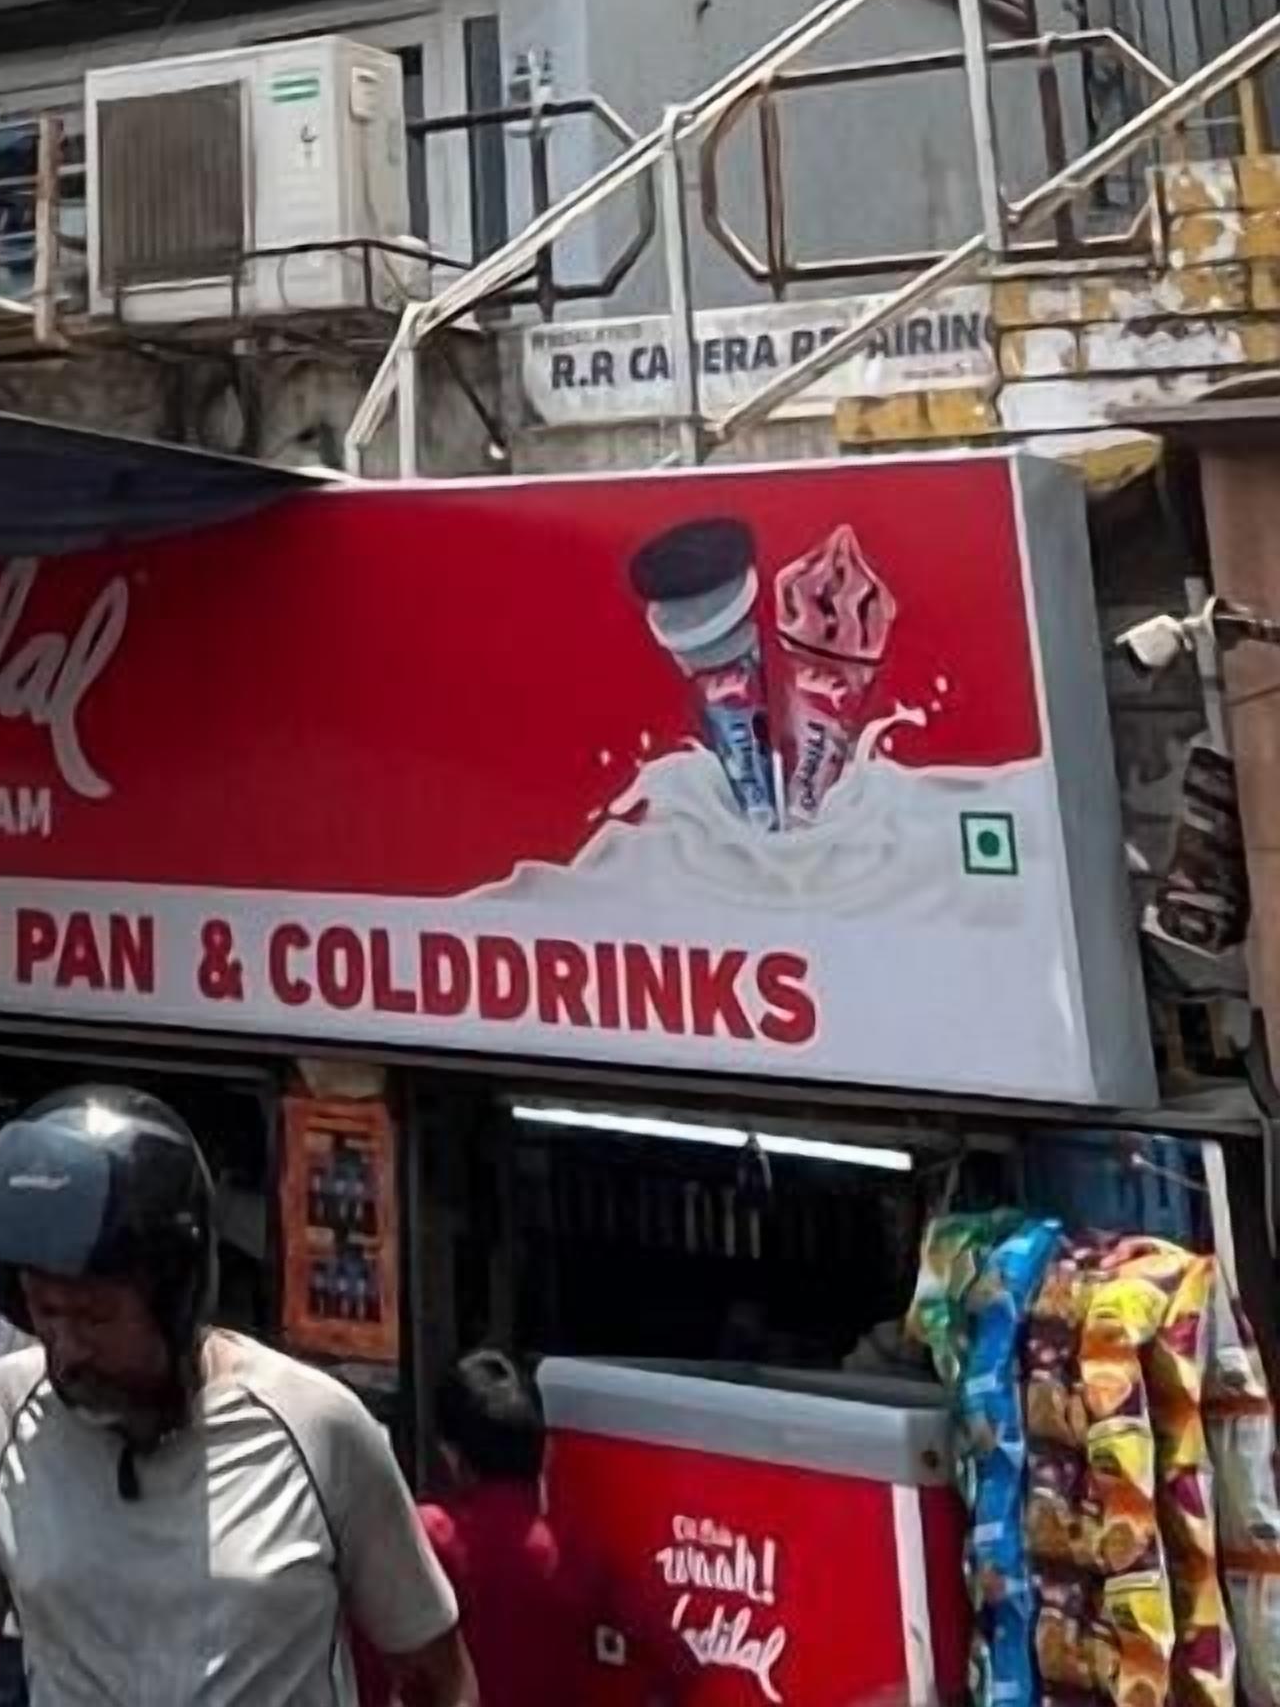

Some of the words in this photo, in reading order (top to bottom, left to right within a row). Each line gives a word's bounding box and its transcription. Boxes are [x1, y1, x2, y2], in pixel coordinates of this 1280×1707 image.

[628, 334, 777, 382] CAERA
[791, 310, 995, 365] RAIRIN
[15, 907, 156, 994] PAN
[197, 918, 245, 1002] &
[267, 922, 819, 1045] COLDDRINKS
